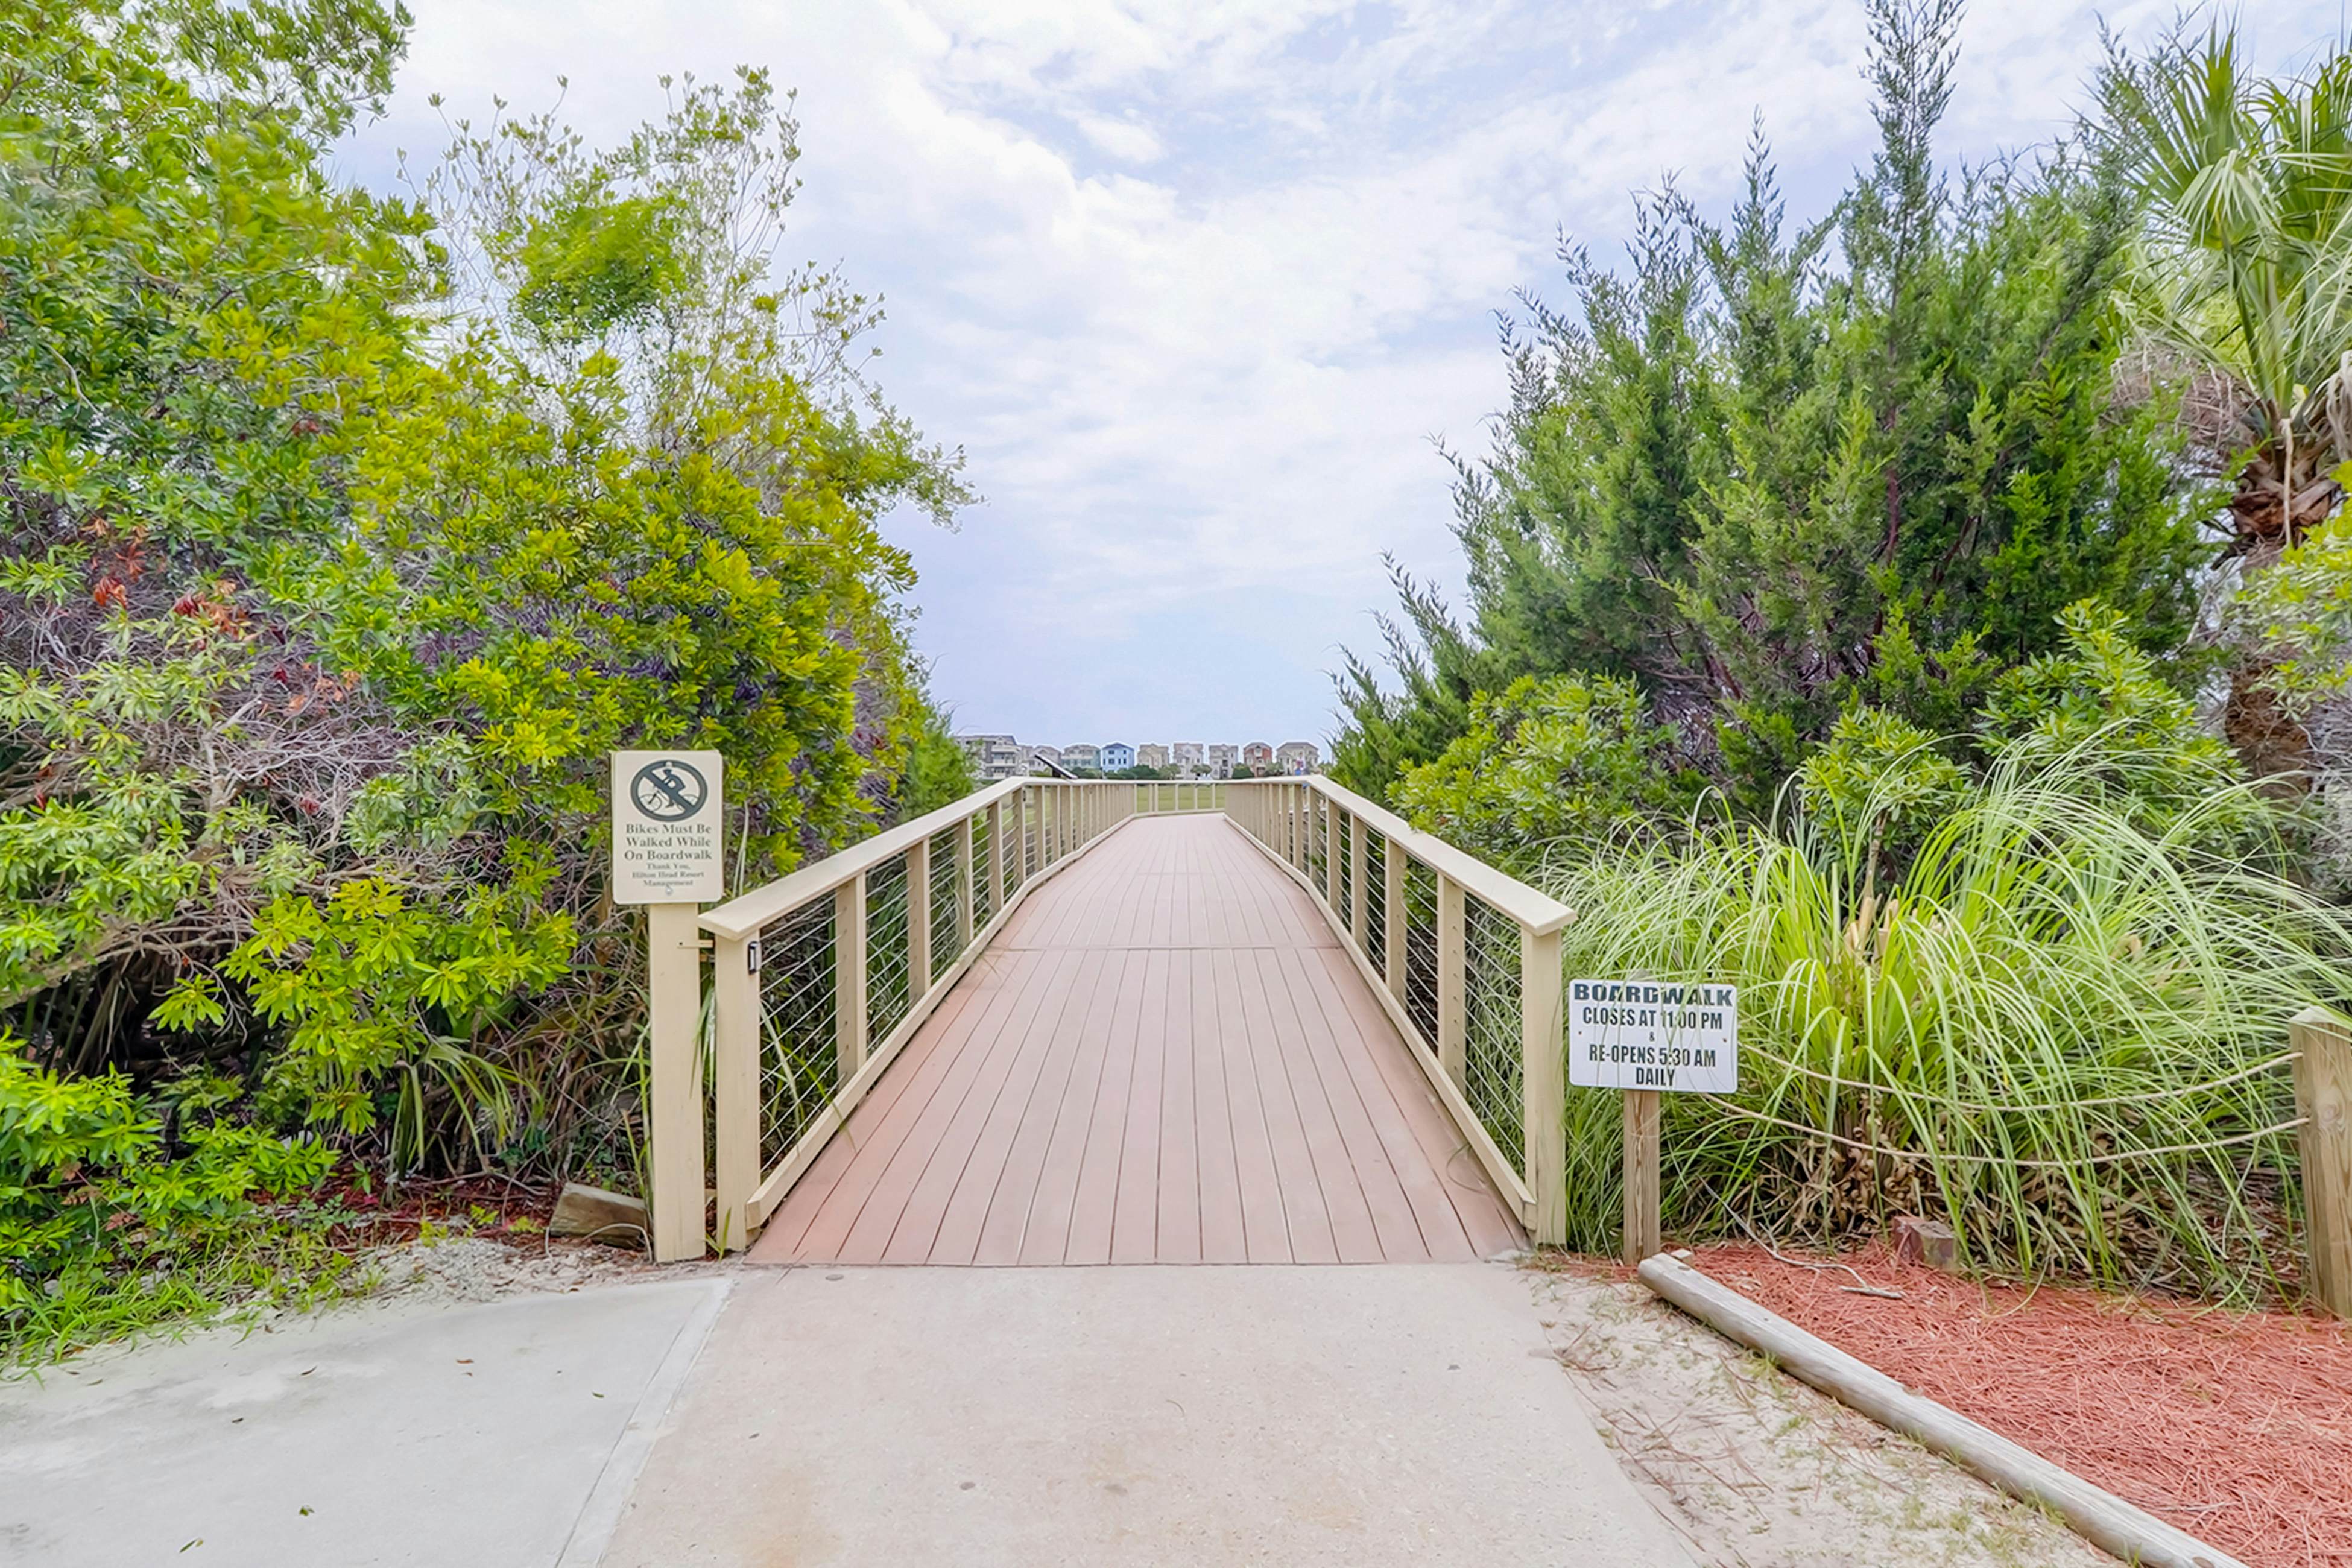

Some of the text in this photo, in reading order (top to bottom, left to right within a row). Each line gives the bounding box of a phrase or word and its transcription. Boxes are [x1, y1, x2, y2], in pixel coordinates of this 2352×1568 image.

[625, 823, 712, 834] Bikes Must Be
[626, 836, 711, 847] Walked While
[624, 849, 712, 860] On Boardwalk
[1574, 984, 1733, 1007] BOARDWALK
[1583, 1007, 1635, 1026] CLOSES
[1639, 1010, 1656, 1027] AT
[1701, 1013, 1722, 1030] PM
[1649, 1032, 1655, 1042] &
[1589, 1044, 1716, 1067] RE-OPENS 5:30 AM
[1636, 1067, 1675, 1086] DAILY
